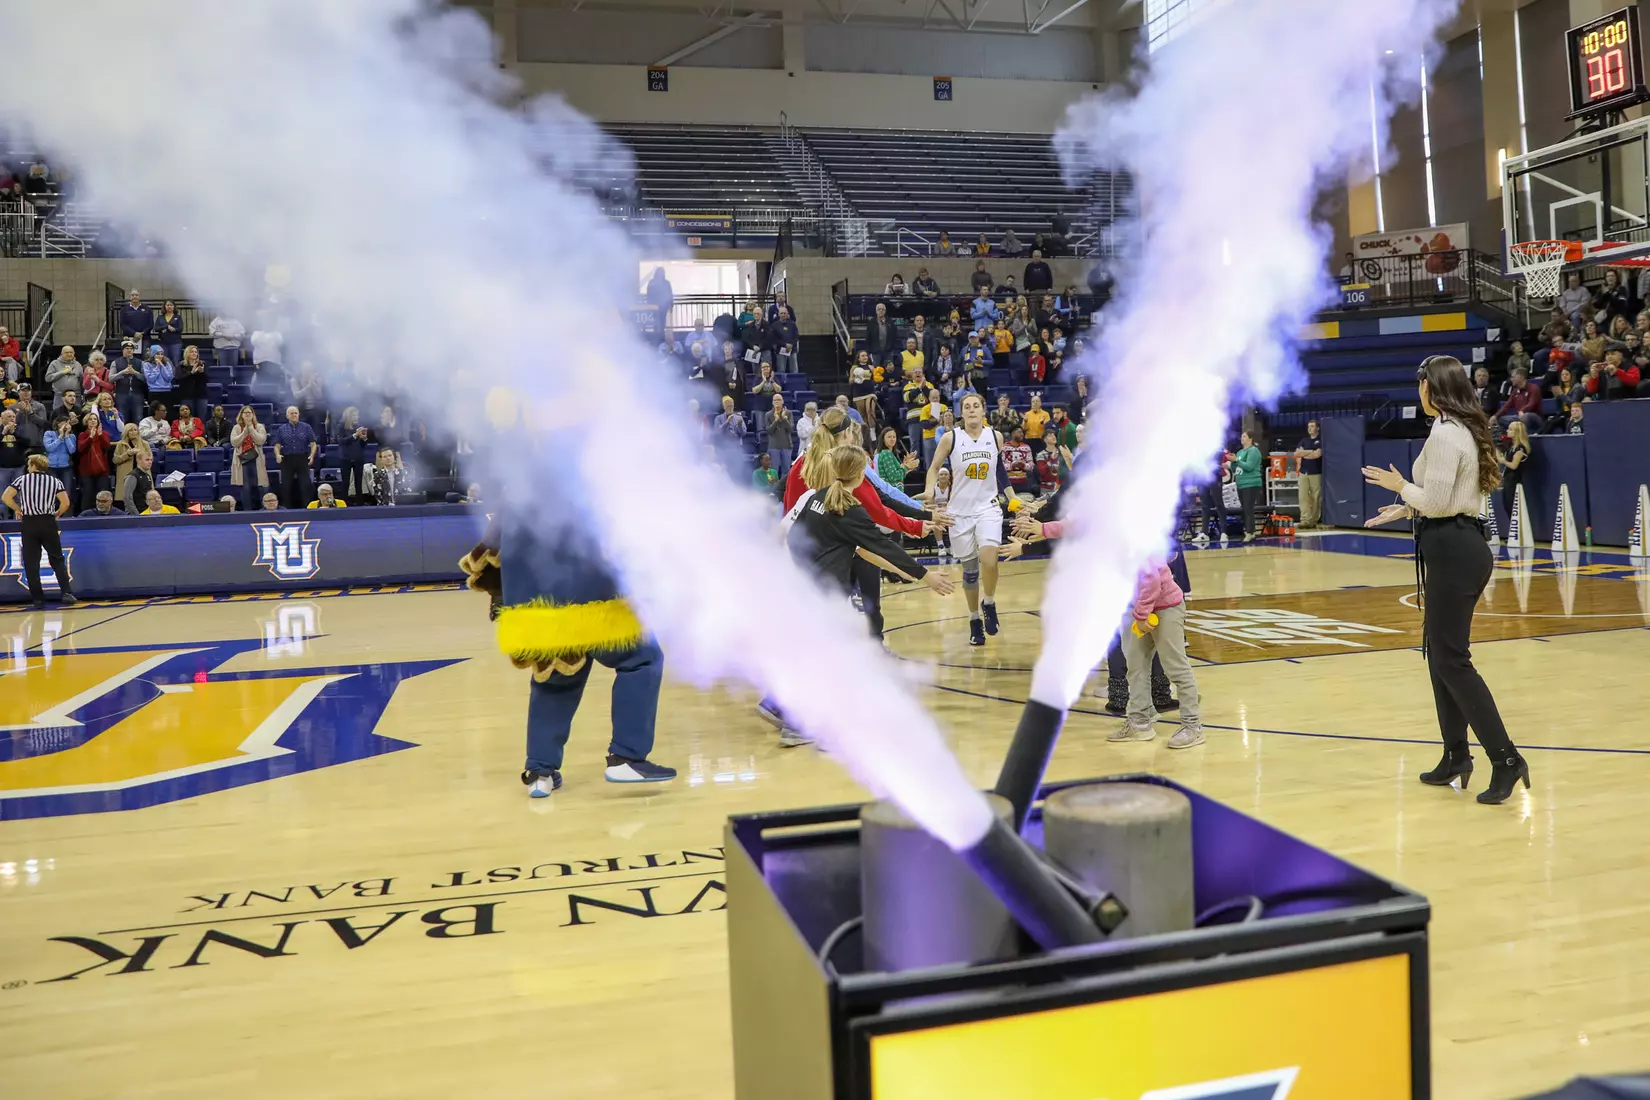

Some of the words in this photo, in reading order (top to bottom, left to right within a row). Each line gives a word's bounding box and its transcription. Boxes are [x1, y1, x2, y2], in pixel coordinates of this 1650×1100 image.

[1583, 20, 1627, 55] 10:00
[650, 71, 665, 79] 204
[1587, 48, 1625, 98] 30
[652, 81, 664, 90] GA
[936, 81, 950, 90] 205
[938, 91, 949, 100] GA
[1360, 239, 1391, 250] CHUCK
[1346, 291, 1365, 303] 106
[965, 461, 990, 481] 42
[259, 525, 315, 576] MU
[175, 876, 400, 914] BANK
[33, 900, 508, 986] BANK
